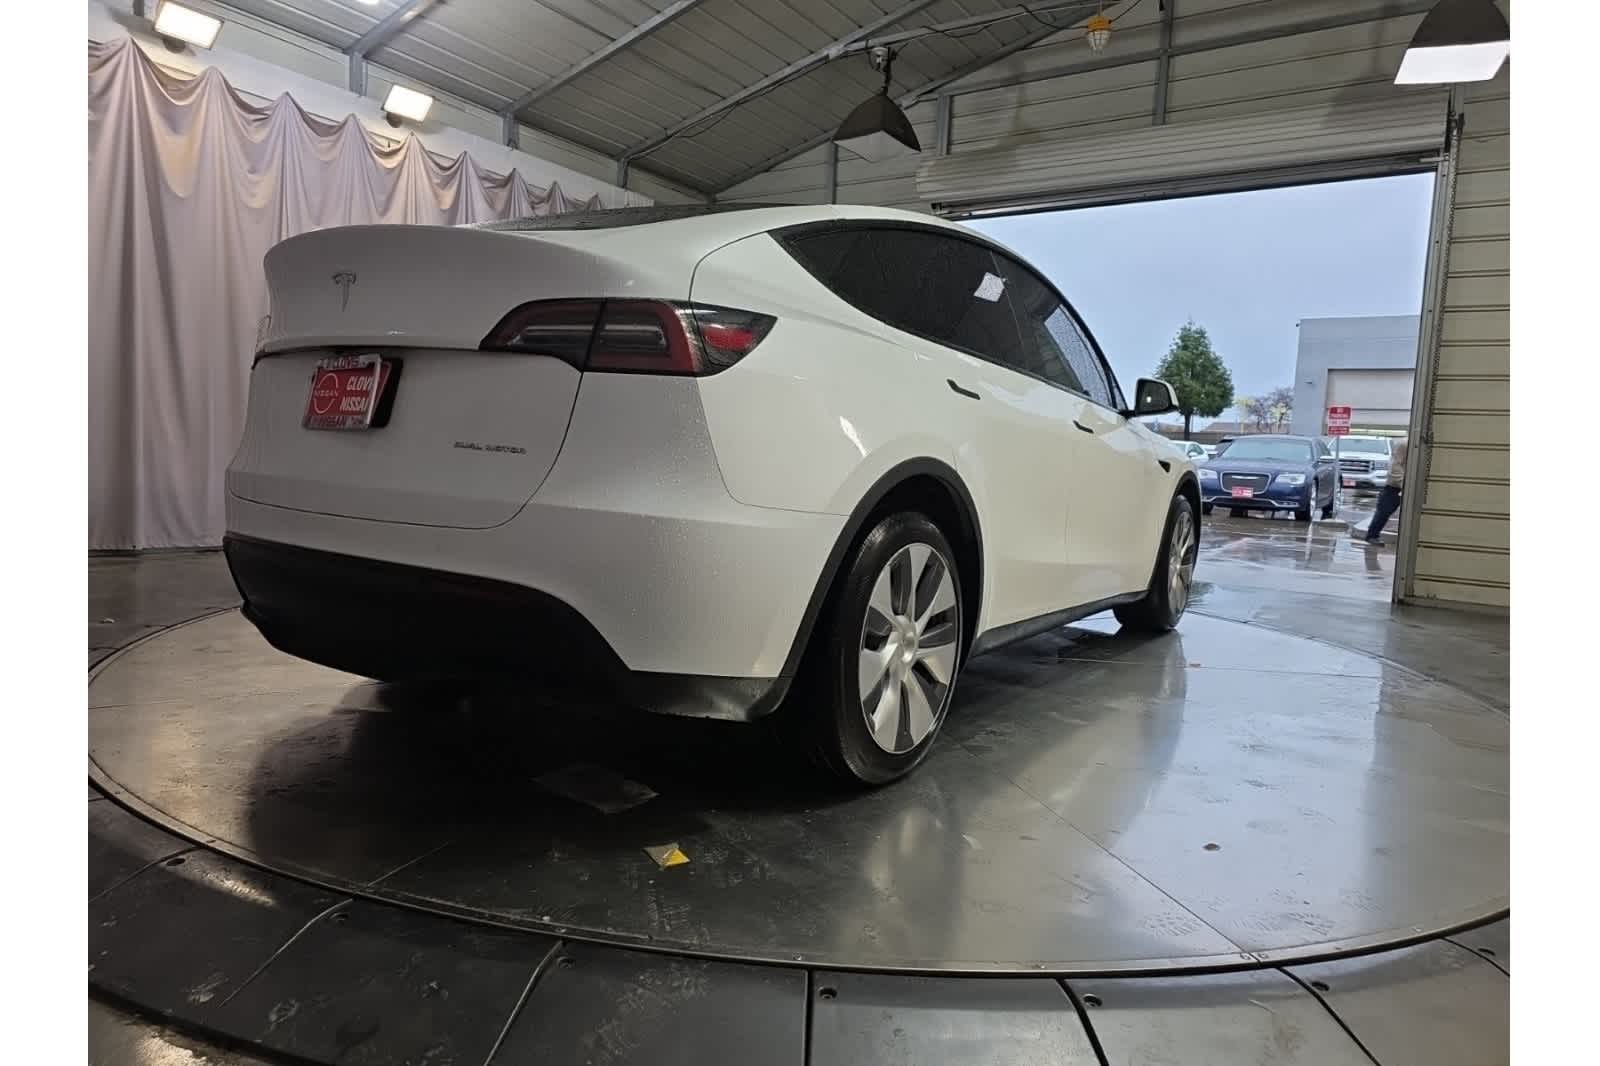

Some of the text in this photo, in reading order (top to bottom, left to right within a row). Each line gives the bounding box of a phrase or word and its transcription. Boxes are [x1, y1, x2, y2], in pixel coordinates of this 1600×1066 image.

[346, 375, 375, 391] CLOVI
[314, 389, 339, 397] NISSAN
[453, 441, 527, 454] DUAL MOTOR
